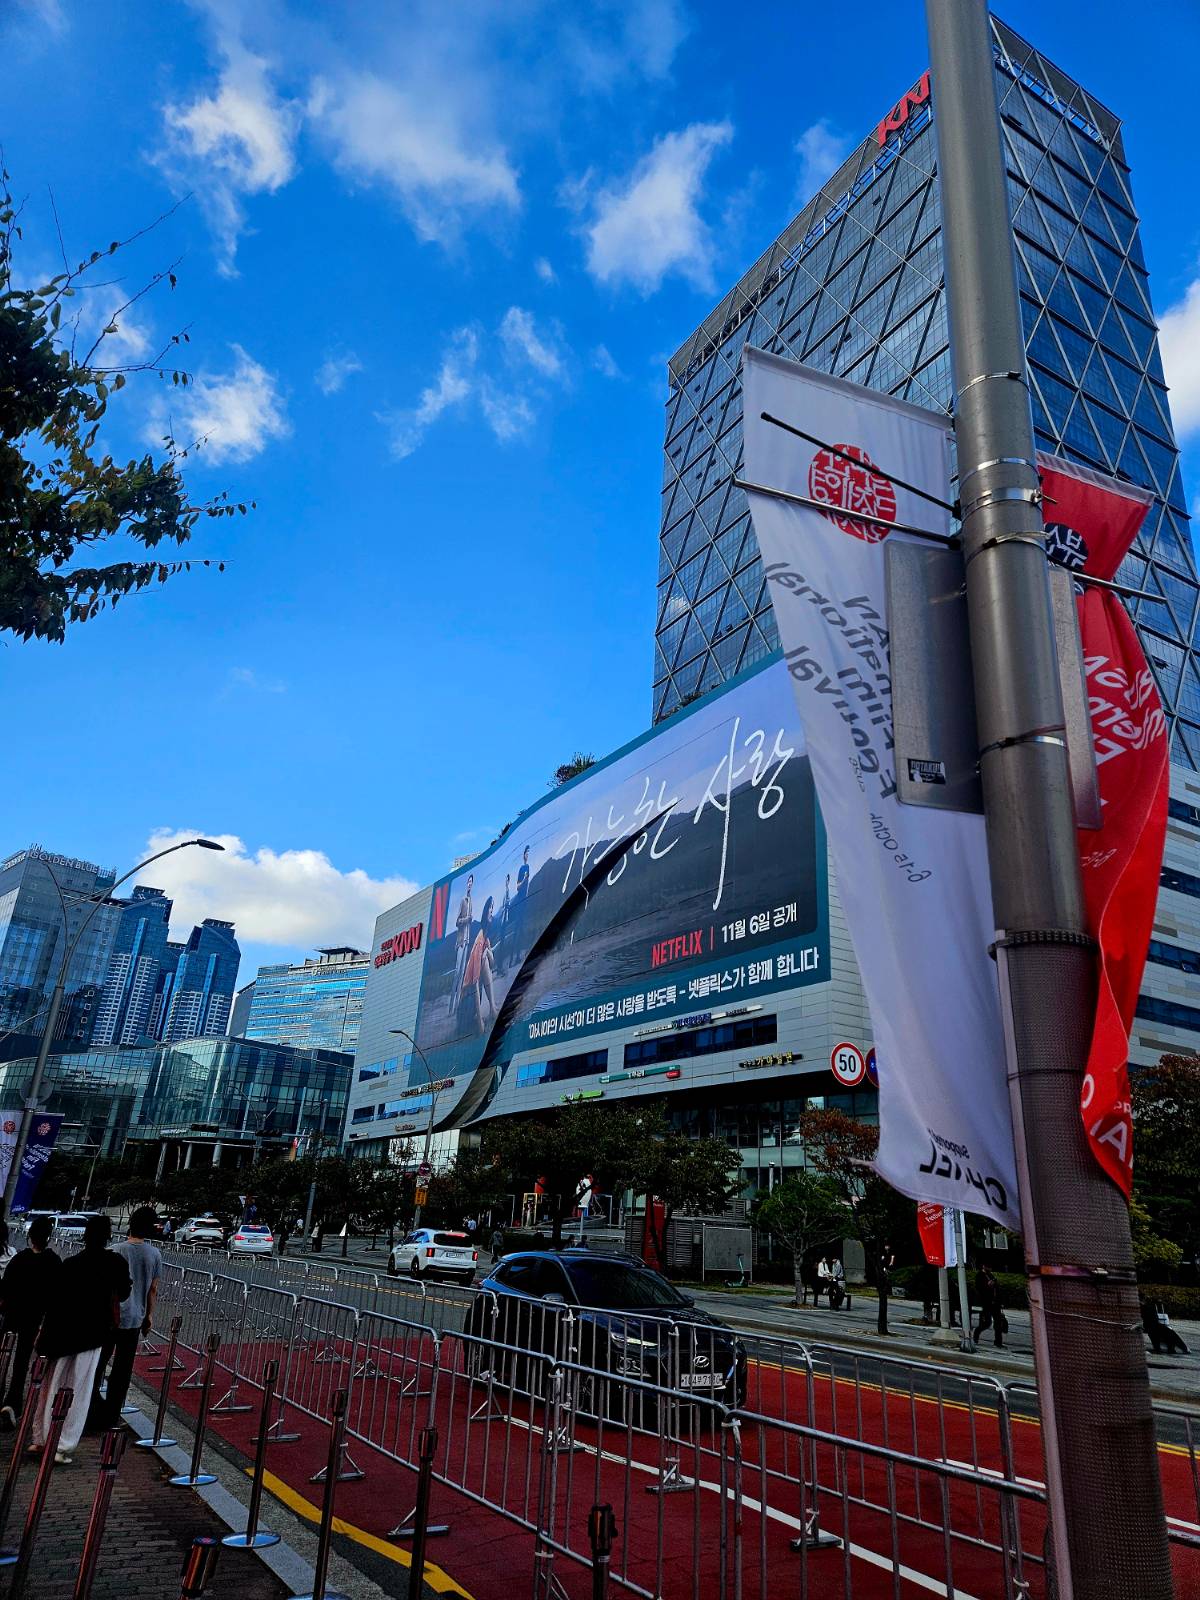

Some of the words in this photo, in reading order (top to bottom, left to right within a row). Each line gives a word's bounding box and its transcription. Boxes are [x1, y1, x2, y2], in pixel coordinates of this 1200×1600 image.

[694, 717, 795, 911] 사랑
[30, 850, 74, 869] GOLDEN
[75, 861, 98, 875] BLUE
[652, 928, 703, 968] NETFLIX
[721, 918, 746, 944] 11월
[749, 910, 770, 935] 6일
[773, 902, 798, 928] 공개
[586, 1005, 596, 1025] 더
[597, 1001, 615, 1023] 많은
[616, 993, 645, 1018] 사랑을
[646, 985, 677, 1010] 받도록
[688, 967, 746, 1000] 넷플릭스가
[747, 958, 773, 983] 함께
[776, 946, 820, 979] 합니다
[839, 1053, 857, 1073] 50
